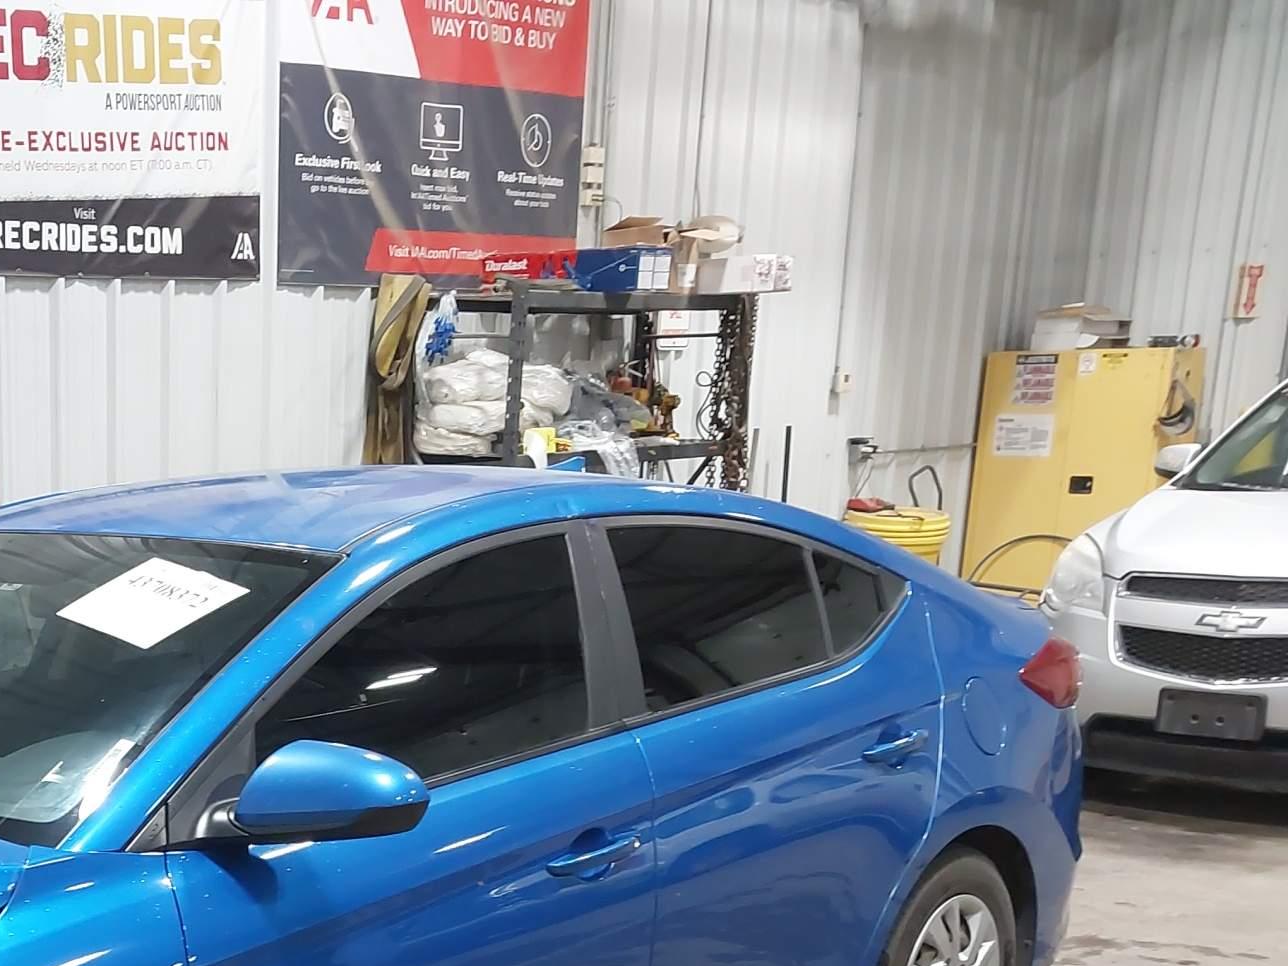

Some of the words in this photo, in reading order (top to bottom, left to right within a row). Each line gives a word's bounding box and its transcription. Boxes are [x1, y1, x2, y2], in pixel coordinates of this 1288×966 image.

[521, 5, 532, 24] A
[535, 7, 566, 28] NEW
[431, 15, 465, 38] WAY
[468, 20, 489, 41] TO
[491, 23, 512, 44] BID
[514, 27, 525, 47] &
[528, 29, 557, 50] BUY
[63, 12, 223, 86] RIDES
[105, 93, 113, 111] A
[115, 93, 183, 111] POWERSPORT
[184, 94, 223, 112] AUCTION
[150, 131, 230, 152] AUCTION
[23, 160, 87, 174] Wednesdays
[101, 162, 127, 172] noon
[130, 160, 144, 172] ET
[295, 152, 340, 169] Exclusive
[450, 167, 470, 182] Easy
[73, 207, 97, 220] Visit
[388, 244, 410, 258] Visit
